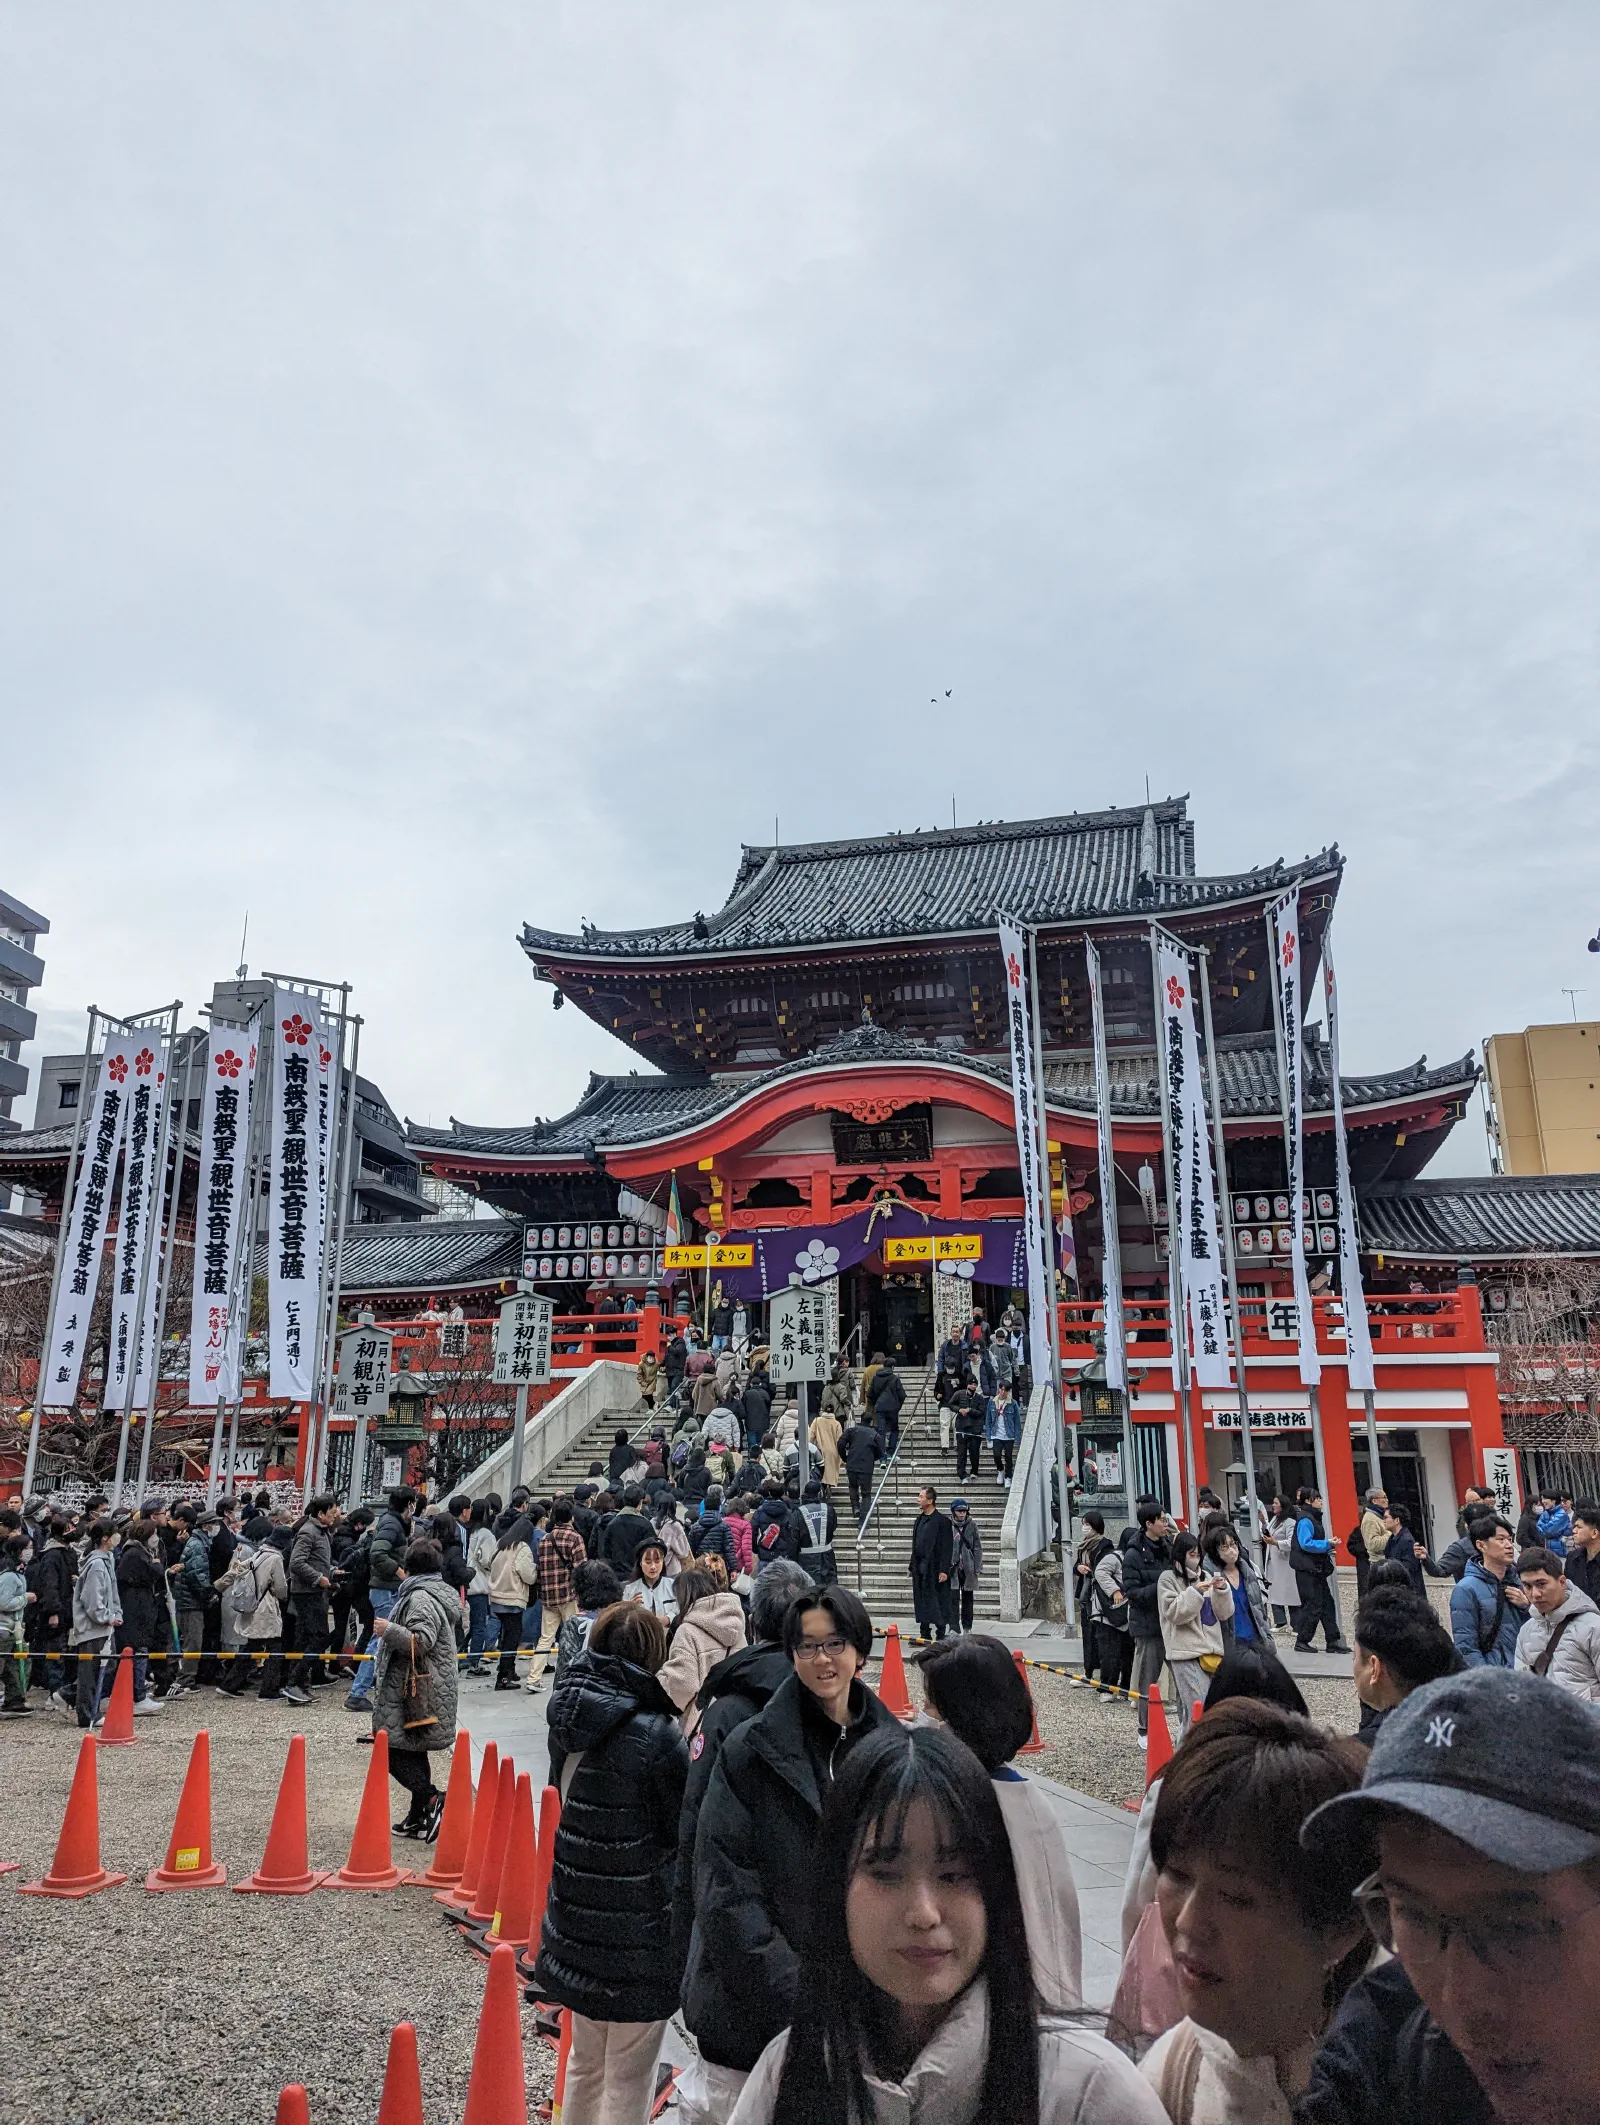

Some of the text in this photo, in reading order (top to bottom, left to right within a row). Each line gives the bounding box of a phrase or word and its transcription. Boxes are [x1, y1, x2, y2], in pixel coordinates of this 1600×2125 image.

[120, 1084, 150, 1295] 南無聖観世音菩薩
[204, 1085, 239, 1295] 南無聖観世音菩薩
[279, 1052, 309, 1280] 南無聖観世音菩薩
[670, 1251, 702, 1264] 降り口
[714, 1248, 747, 1262] 登り口
[893, 1241, 975, 1257] 登り口 降り口
[205, 1307, 221, 1348] 矢場とん
[285, 1300, 300, 1368] 仁王門通り
[514, 1303, 525, 1321] 開運
[526, 1302, 536, 1321] 新年
[797, 1298, 814, 1356] 左義長
[1198, 1289, 1219, 1355] 工藤倉鍵
[1269, 1302, 1298, 1337] 年
[116, 1312, 128, 1384] 大須観音通り
[375, 1342, 389, 1393] 一月十八日
[510, 1323, 535, 1380] 初祈祷
[780, 1313, 796, 1371] 火祭り
[351, 1338, 377, 1406] 初観音
[1424, 1715, 1456, 1748] NY
